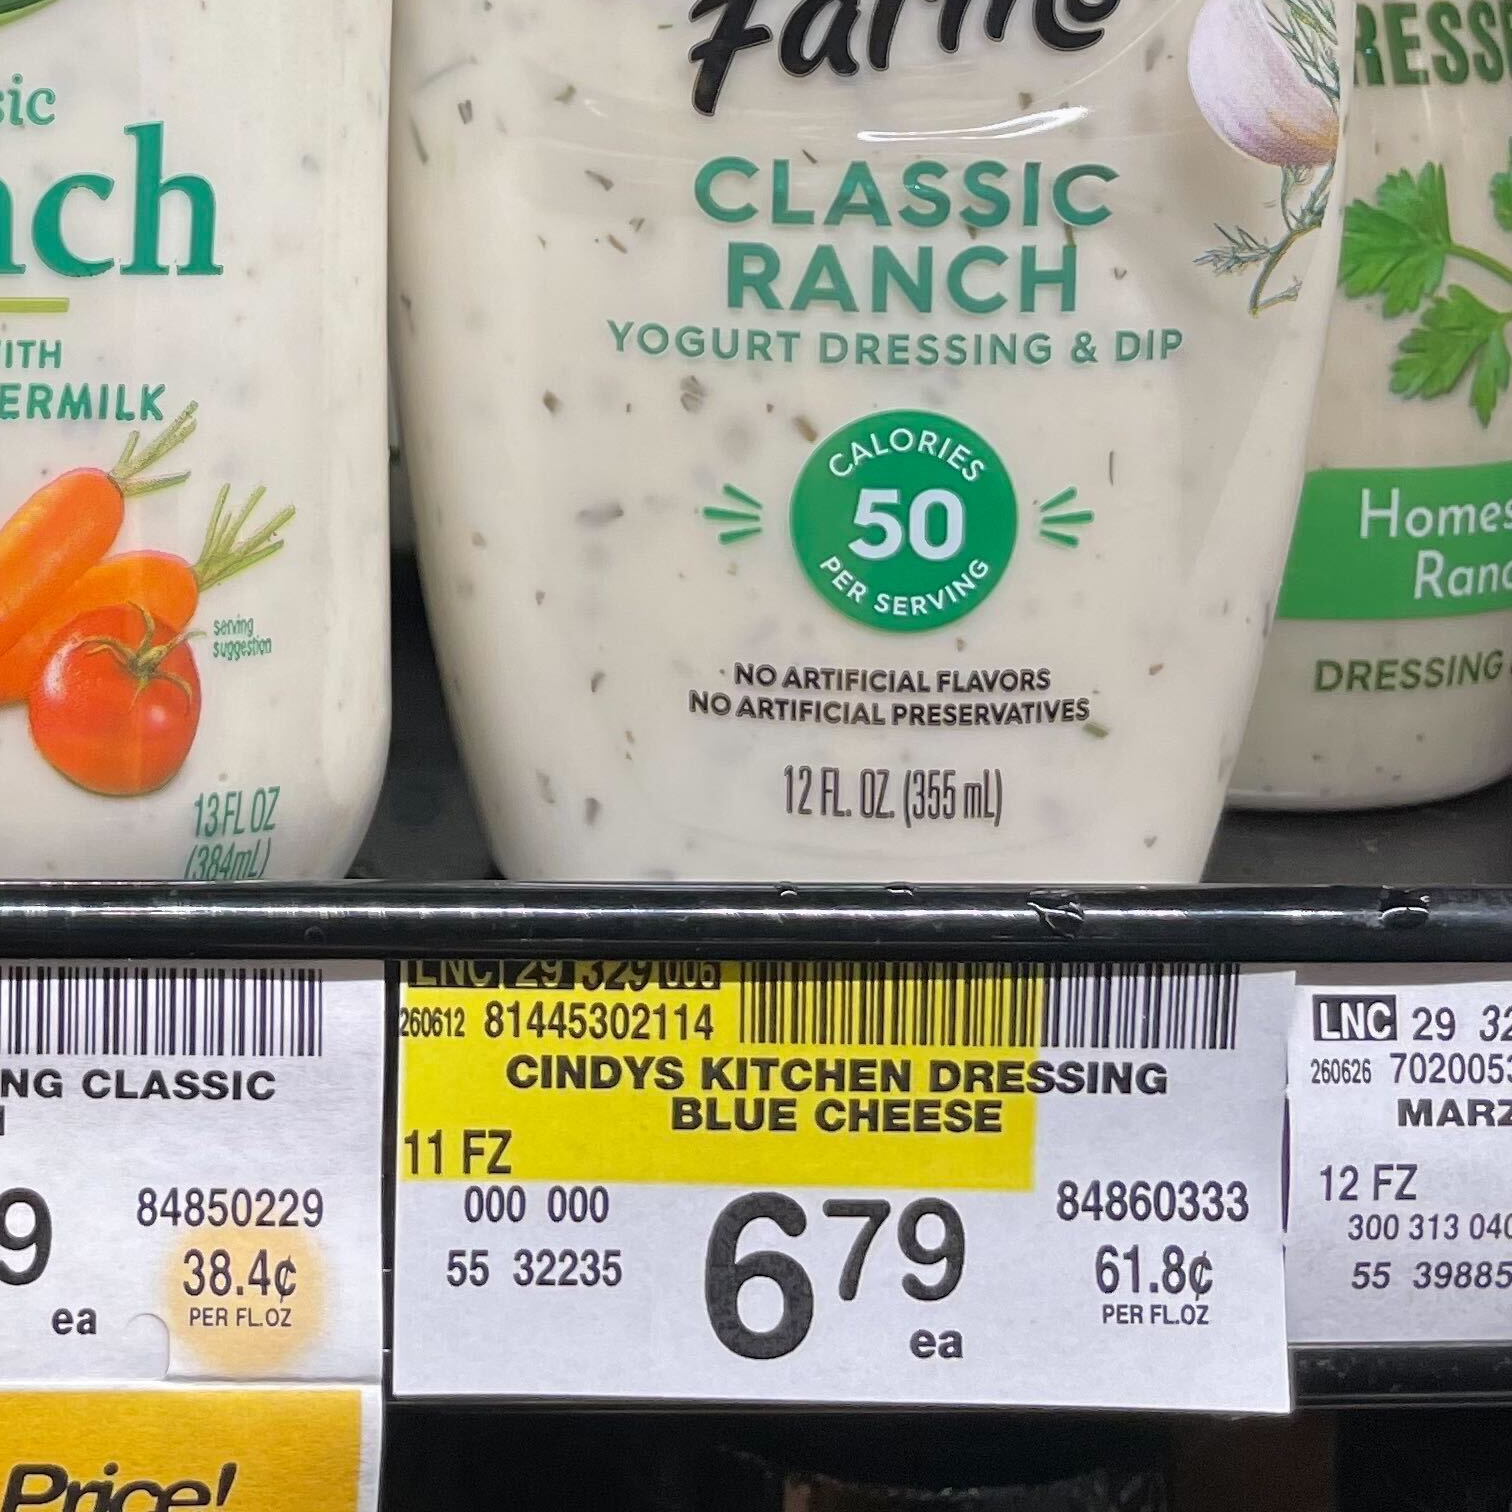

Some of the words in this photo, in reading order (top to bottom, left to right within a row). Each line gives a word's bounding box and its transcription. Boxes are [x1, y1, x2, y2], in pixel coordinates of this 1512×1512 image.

[693, 155, 1120, 229] CLASSIC
[726, 241, 1079, 314] RANCH
[607, 319, 801, 363] YOGURT
[819, 331, 1053, 366] DRESSING
[1071, 332, 1098, 365] &
[1115, 327, 1185, 363] DIP
[828, 428, 986, 482] CALORIES
[848, 488, 964, 561] 50
[819, 555, 866, 604] PER
[873, 558, 989, 616] SERVING
[214, 615, 254, 637] serving
[213, 636, 272, 661] suggestion
[734, 663, 776, 687] NO
[782, 666, 930, 693] ARTIFICIAL
[936, 668, 1051, 693] FLAVORS
[1314, 649, 1503, 691] DRESSING
[689, 690, 732, 716] NO
[735, 695, 886, 726] ARTIFICIAL
[891, 698, 1090, 726] PRESERVATIVES
[194, 792, 219, 837] 13
[222, 790, 244, 835] FL
[250, 785, 280, 832] OZ
[784, 765, 812, 815] 12
[821, 767, 851, 816] FL.
[860, 768, 894, 818] OZ.
[903, 769, 955, 828] (355
[964, 769, 1002, 827] mL)
[400, 1007, 465, 1036] 260612
[485, 1000, 713, 1040] 81445302114
[1320, 1002, 1392, 1040] LNC
[1413, 1007, 1455, 1041] 29
[82, 1070, 276, 1101] CLASSIC
[506, 1055, 684, 1089] CINDYS
[701, 1057, 910, 1093] KITCHEN
[929, 1059, 1168, 1095] DRESSING
[1311, 1058, 1371, 1084] 260626
[672, 1098, 797, 1132] BLUE
[815, 1099, 1002, 1133] CHEESE
[405, 1130, 442, 1174] 11
[463, 1130, 512, 1174] FZ
[1057, 1180, 1249, 1221] 84860333
[1320, 1164, 1358, 1201] 12
[1373, 1163, 1418, 1201] FZ
[137, 1187, 323, 1227] 84850229
[464, 1185, 526, 1222] 000
[548, 1185, 609, 1222] 000
[1348, 1214, 1399, 1240] 300
[1409, 1213, 1458, 1240] 313
[447, 1249, 489, 1286] 55
[513, 1249, 621, 1286] 32235
[1352, 1262, 1391, 1289] 55
[51, 1308, 96, 1334] ea
[190, 1308, 227, 1326] PER
[237, 1308, 291, 1326] FL.OZ
[1103, 1304, 1143, 1324] PER
[1150, 1304, 1209, 1324] FL.OZ
[910, 1329, 963, 1358] ea
